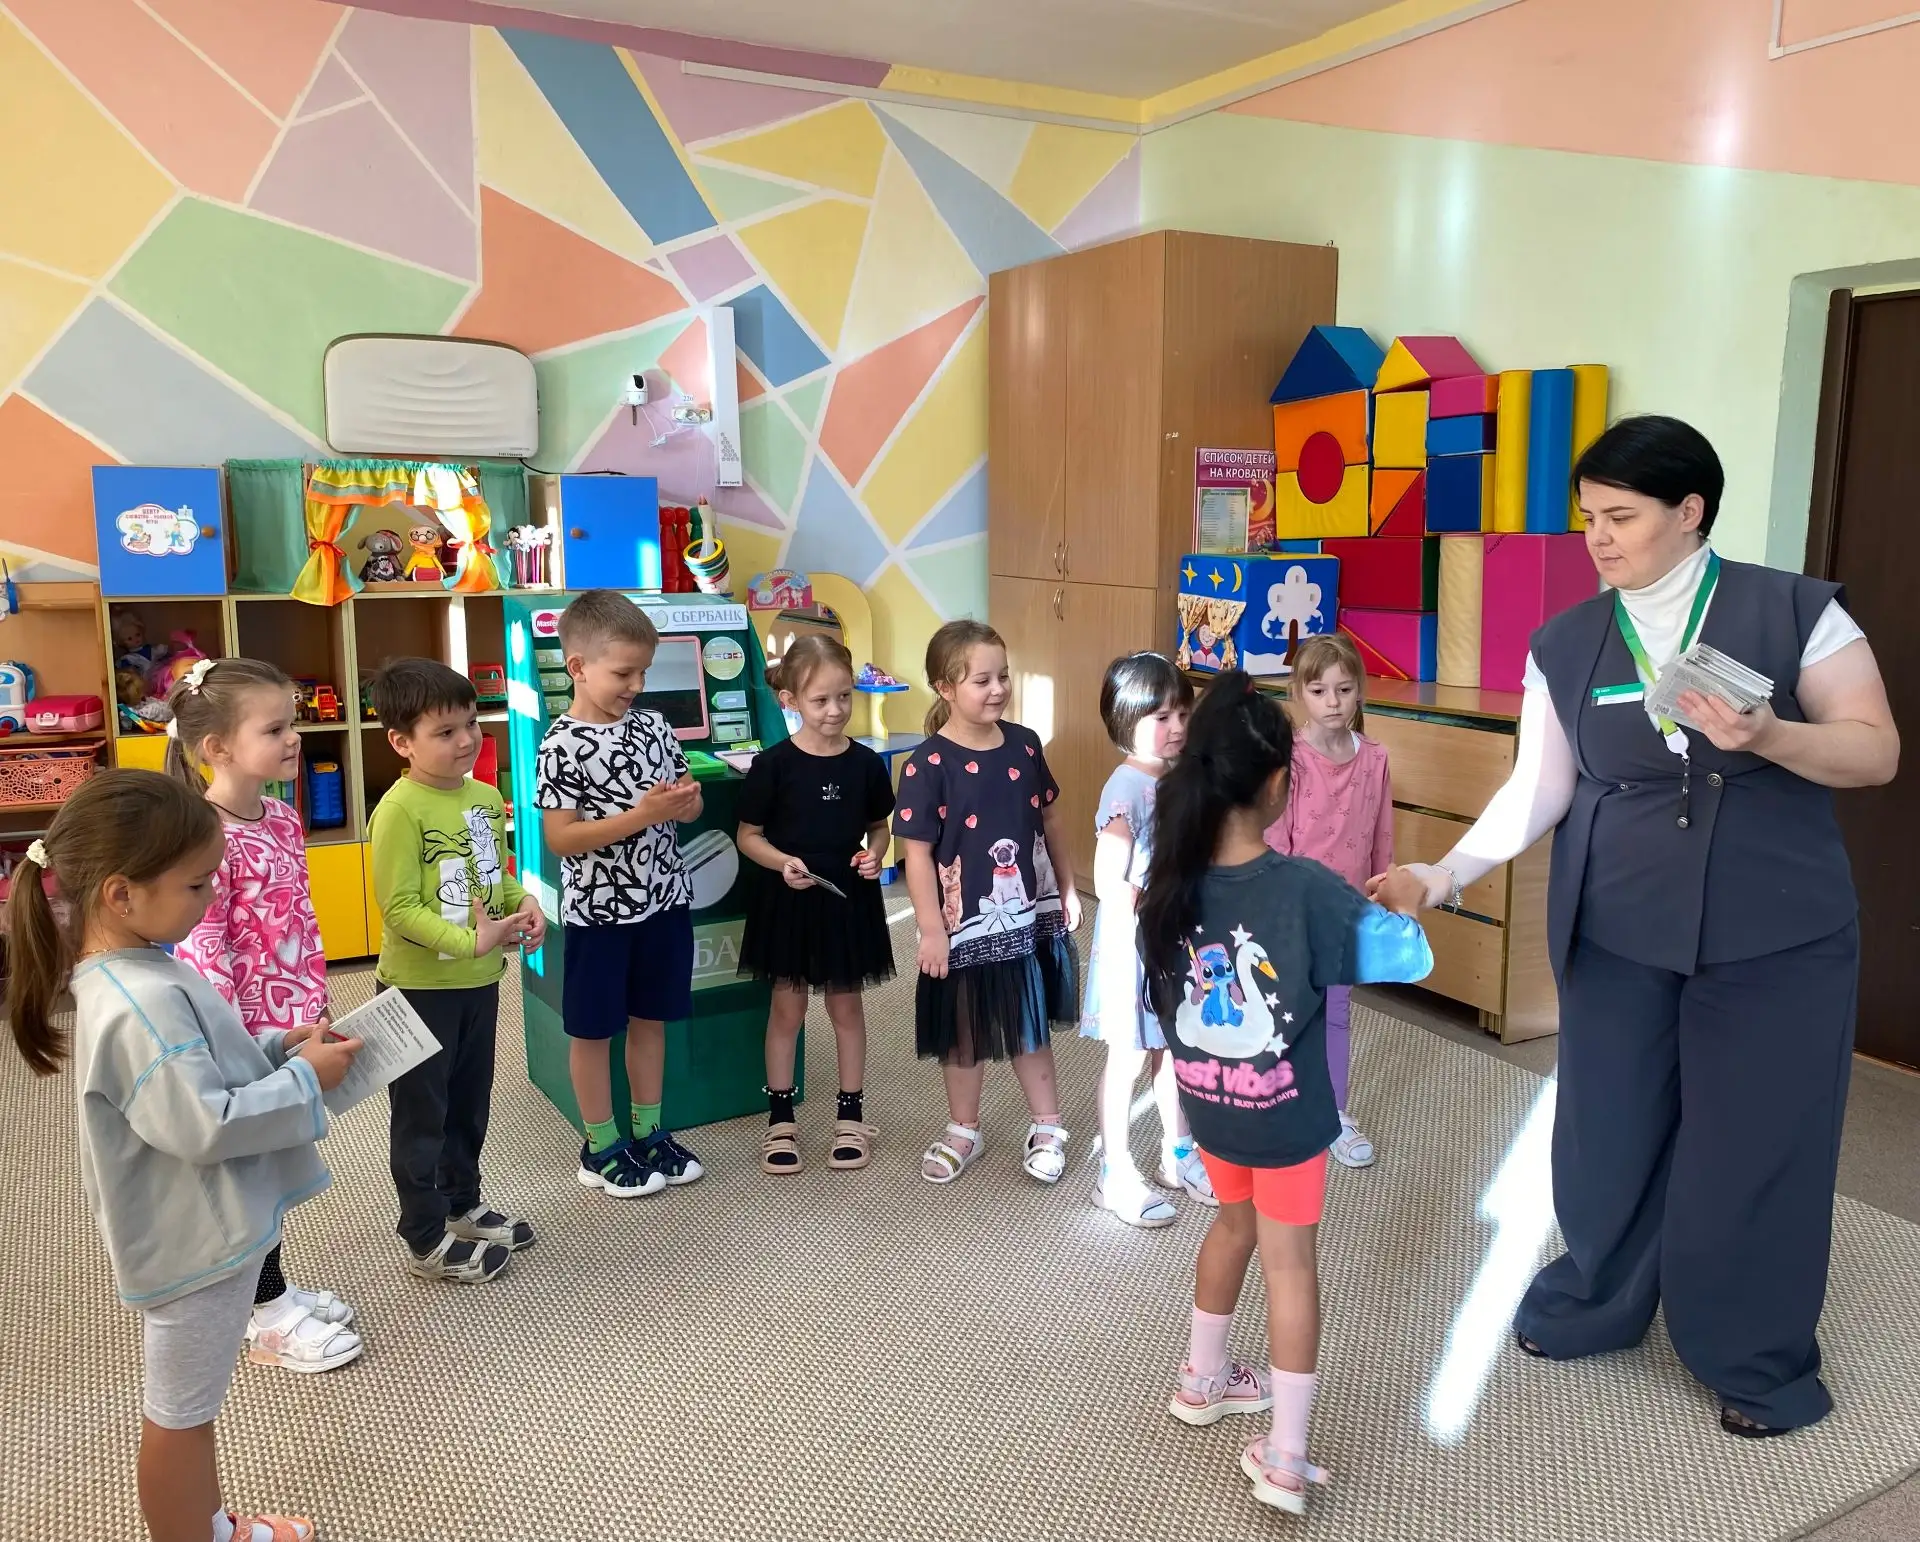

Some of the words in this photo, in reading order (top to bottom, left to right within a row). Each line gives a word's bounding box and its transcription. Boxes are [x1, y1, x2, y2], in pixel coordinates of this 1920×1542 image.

[1204, 452, 1243, 464] СПИСОК
[1244, 451, 1275, 466] ДЕТЕЙ
[1209, 467, 1223, 478] НА
[1225, 468, 1268, 479] КРОВАТИ
[672, 609, 743, 623] СБЕРБАНК
[1174, 1059, 1221, 1090] est
[1222, 1060, 1294, 1097] vibes
